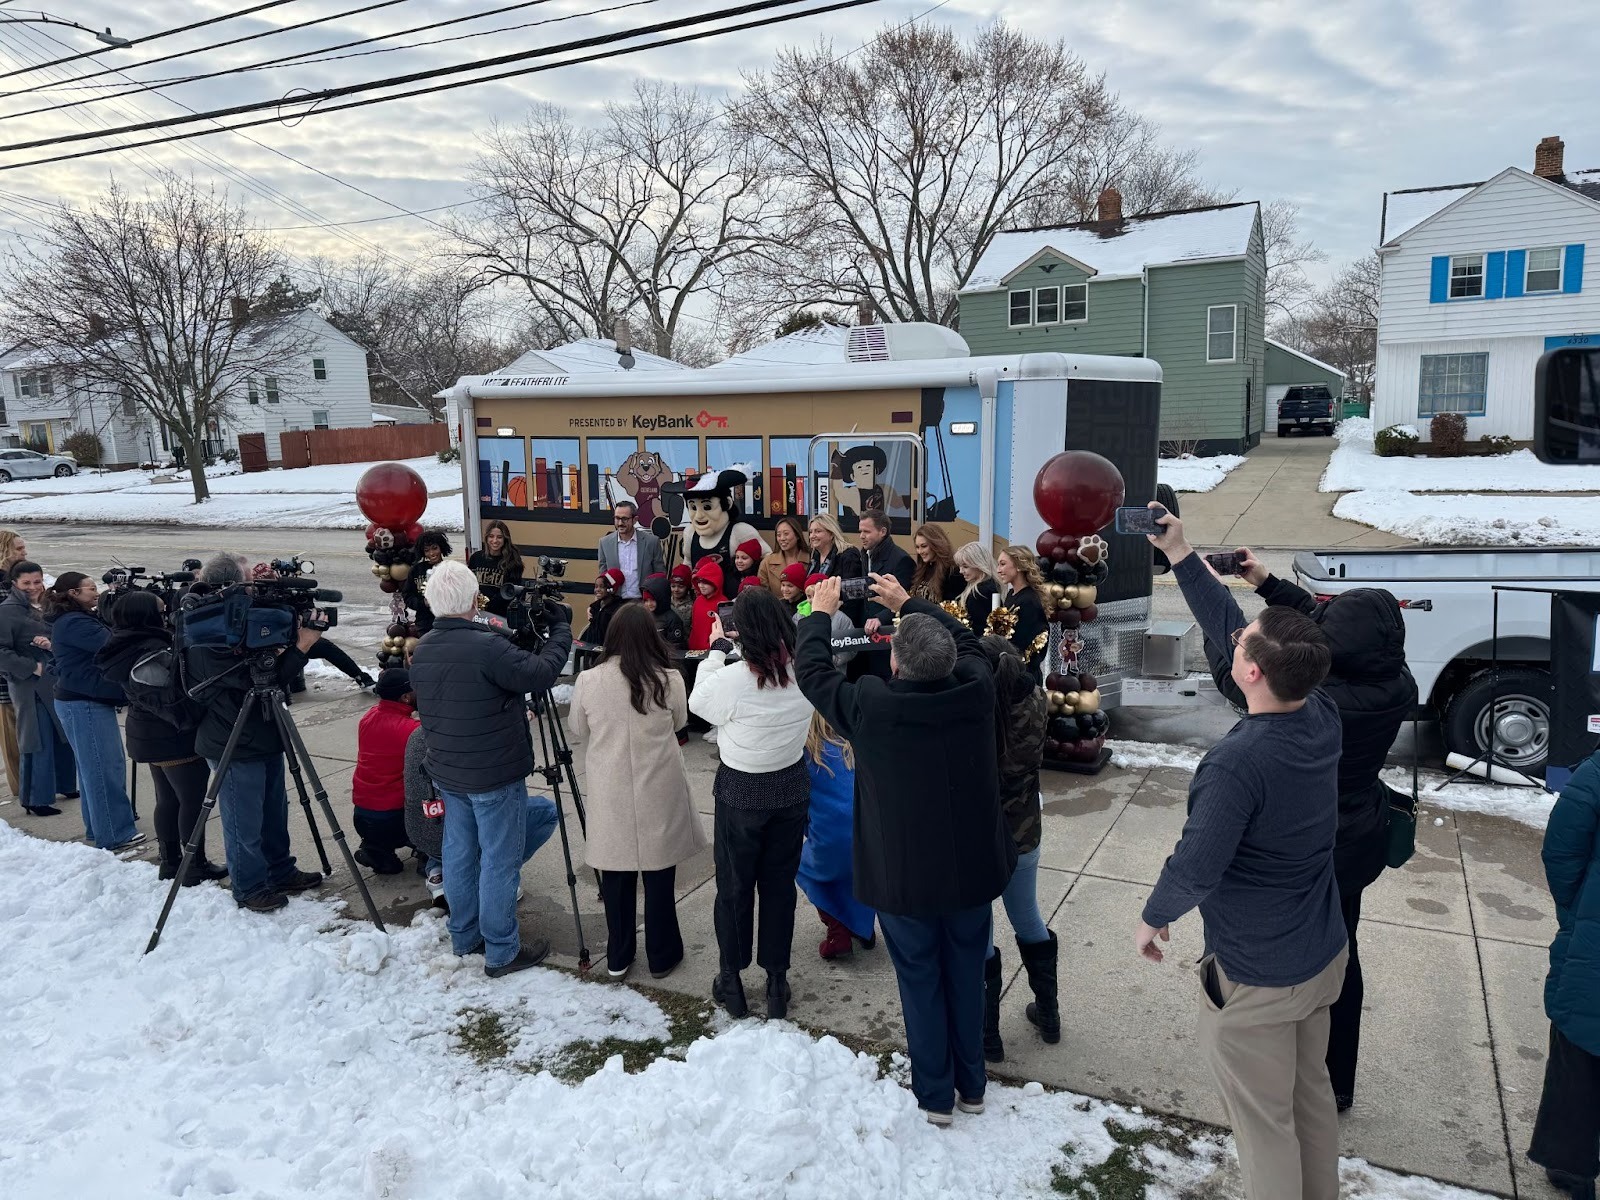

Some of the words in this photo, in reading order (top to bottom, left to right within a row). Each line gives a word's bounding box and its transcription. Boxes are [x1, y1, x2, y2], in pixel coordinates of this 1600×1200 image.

[569, 418, 615, 428] PRESENTED
[617, 418, 628, 428] BY
[632, 414, 694, 431] KeyBank
[820, 485, 828, 509] CAVS
